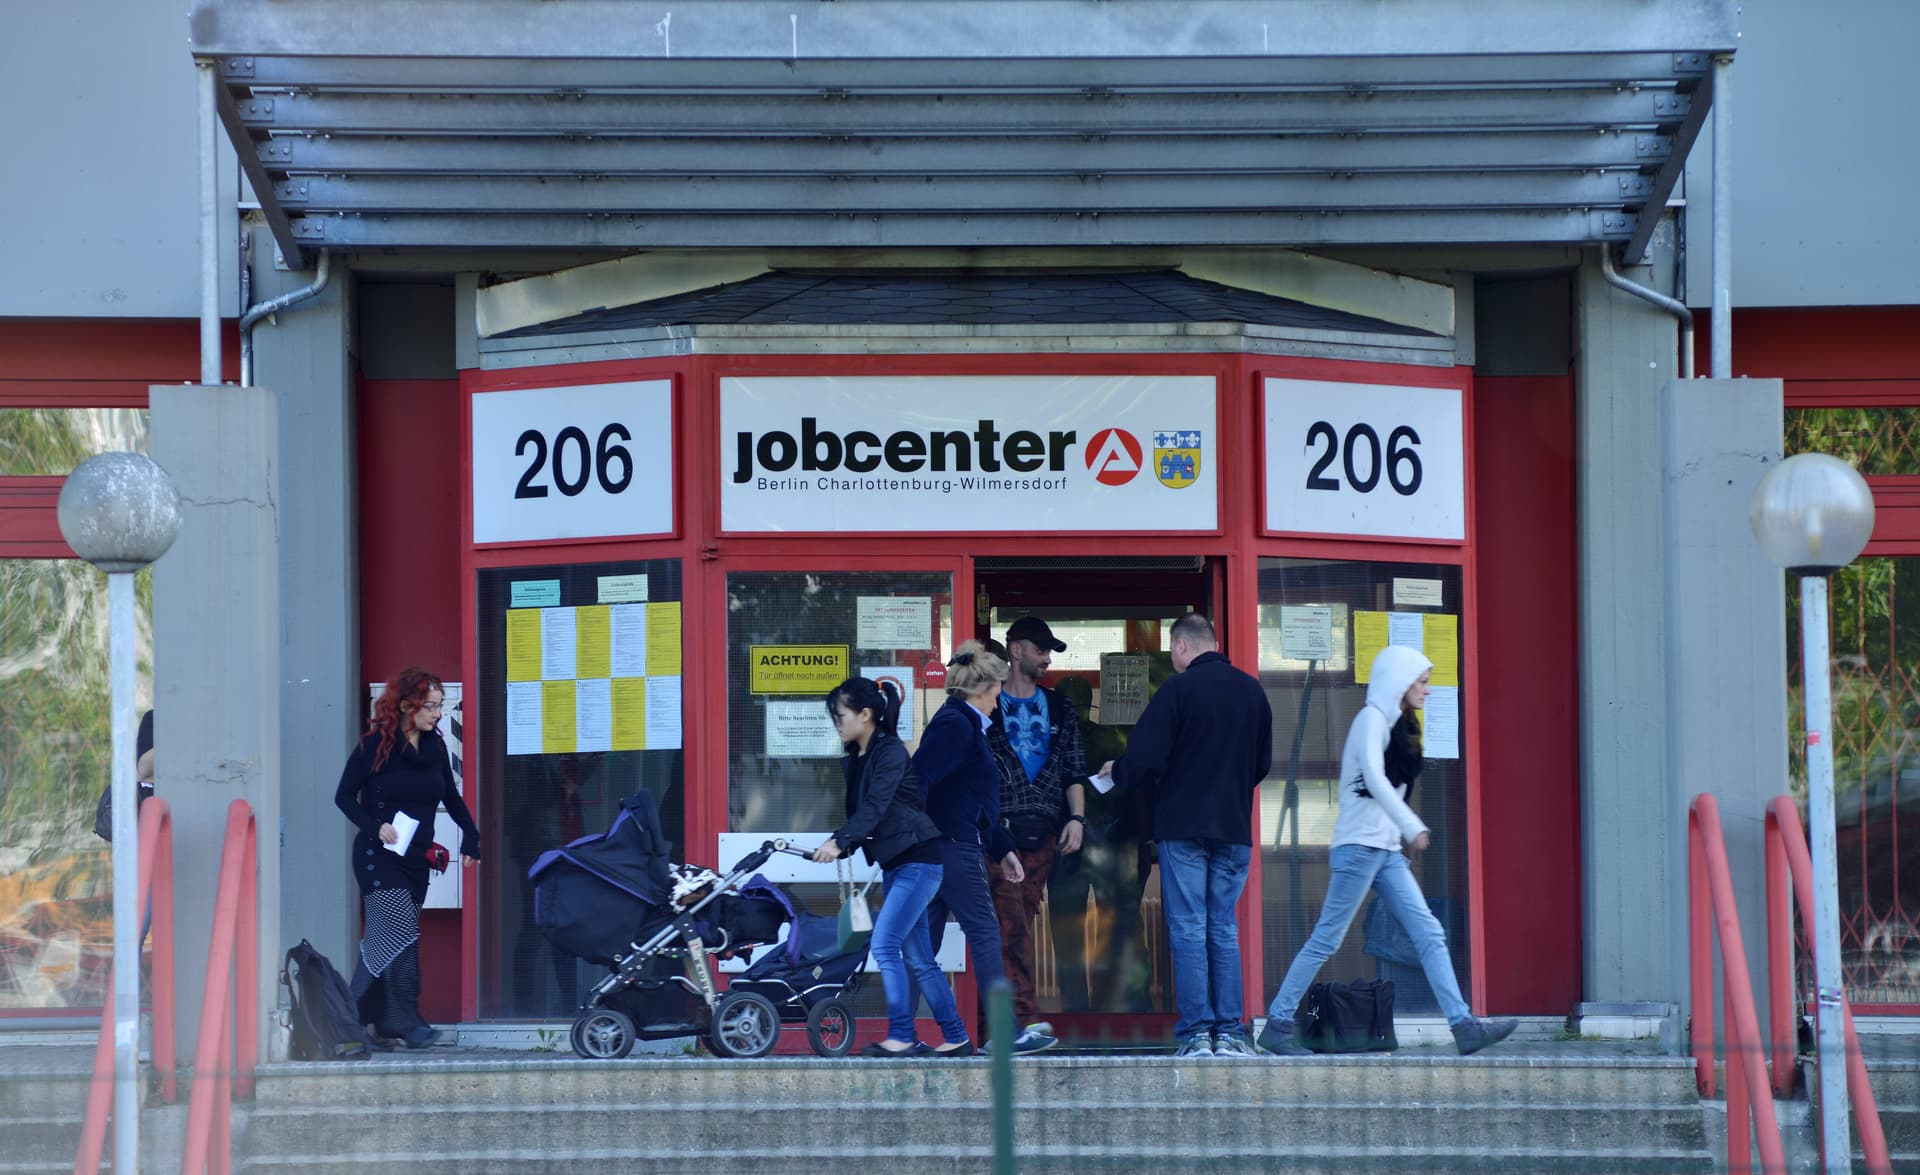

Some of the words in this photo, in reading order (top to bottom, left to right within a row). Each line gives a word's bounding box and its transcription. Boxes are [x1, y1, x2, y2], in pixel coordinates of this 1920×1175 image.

[514, 422, 634, 500] 206
[733, 417, 1077, 484] jobcenter
[1305, 420, 1423, 496] 206
[756, 476, 810, 490] Berlin
[817, 476, 1067, 494] Charlottenburg-Wilmersdorf
[759, 671, 772, 680] Tür
[773, 671, 795, 680] öffnet
[796, 671, 815, 680] nach
[816, 671, 840, 680] außen
[760, 655, 839, 666] ACHTUNG!
